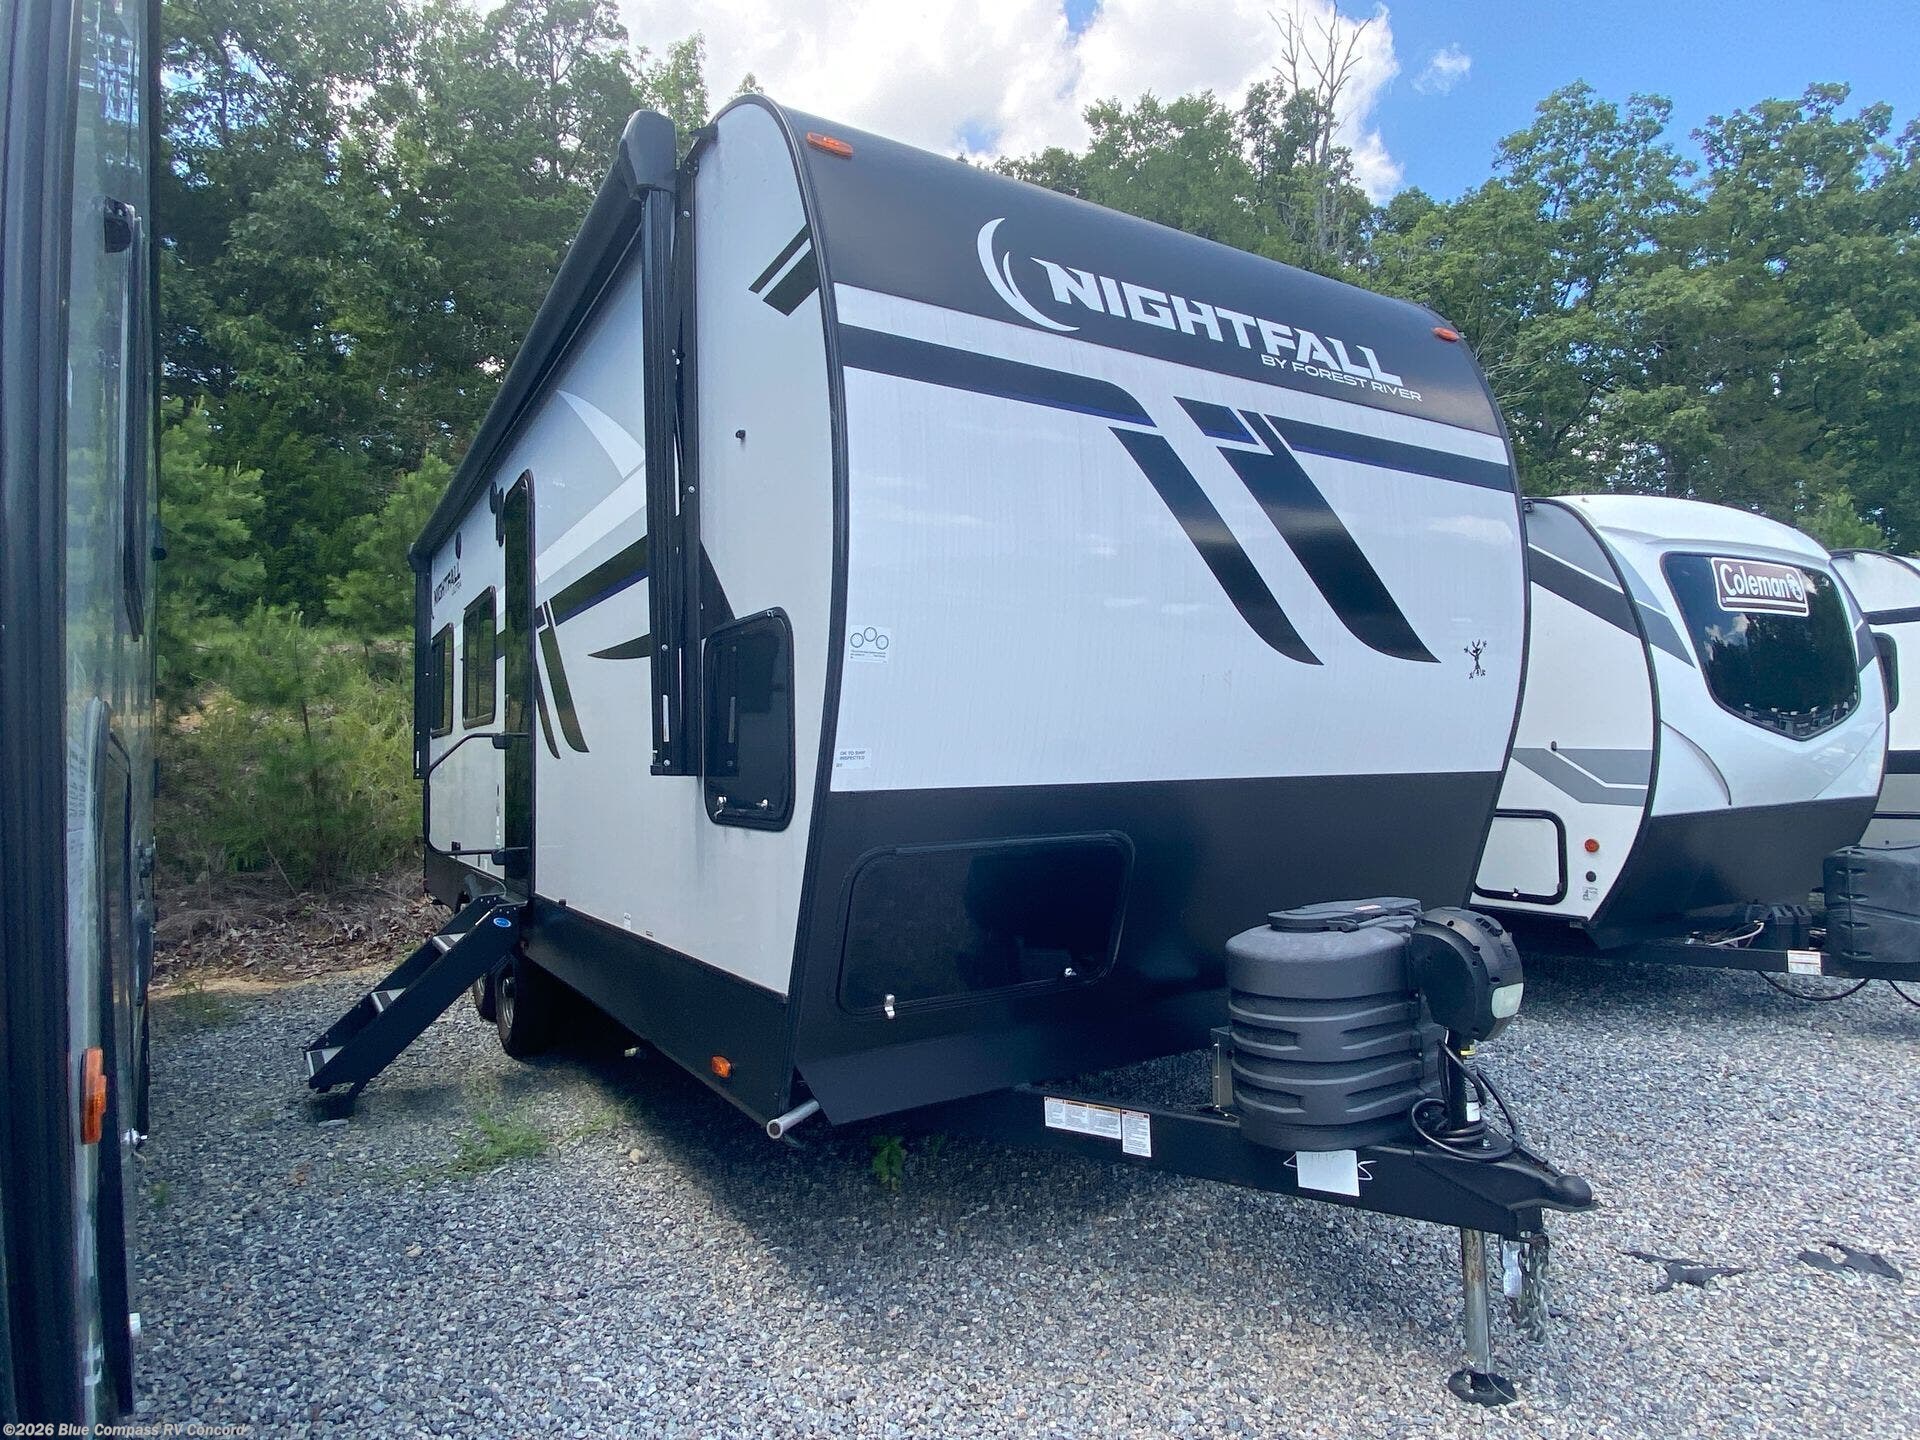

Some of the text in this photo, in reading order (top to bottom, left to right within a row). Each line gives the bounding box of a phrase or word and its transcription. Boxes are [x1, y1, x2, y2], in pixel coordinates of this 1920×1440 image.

[1030, 257, 1403, 386] NIGHTFALL
[1261, 354, 1423, 402] BY FOREST RIVER
[1720, 563, 1791, 599] Coleman
